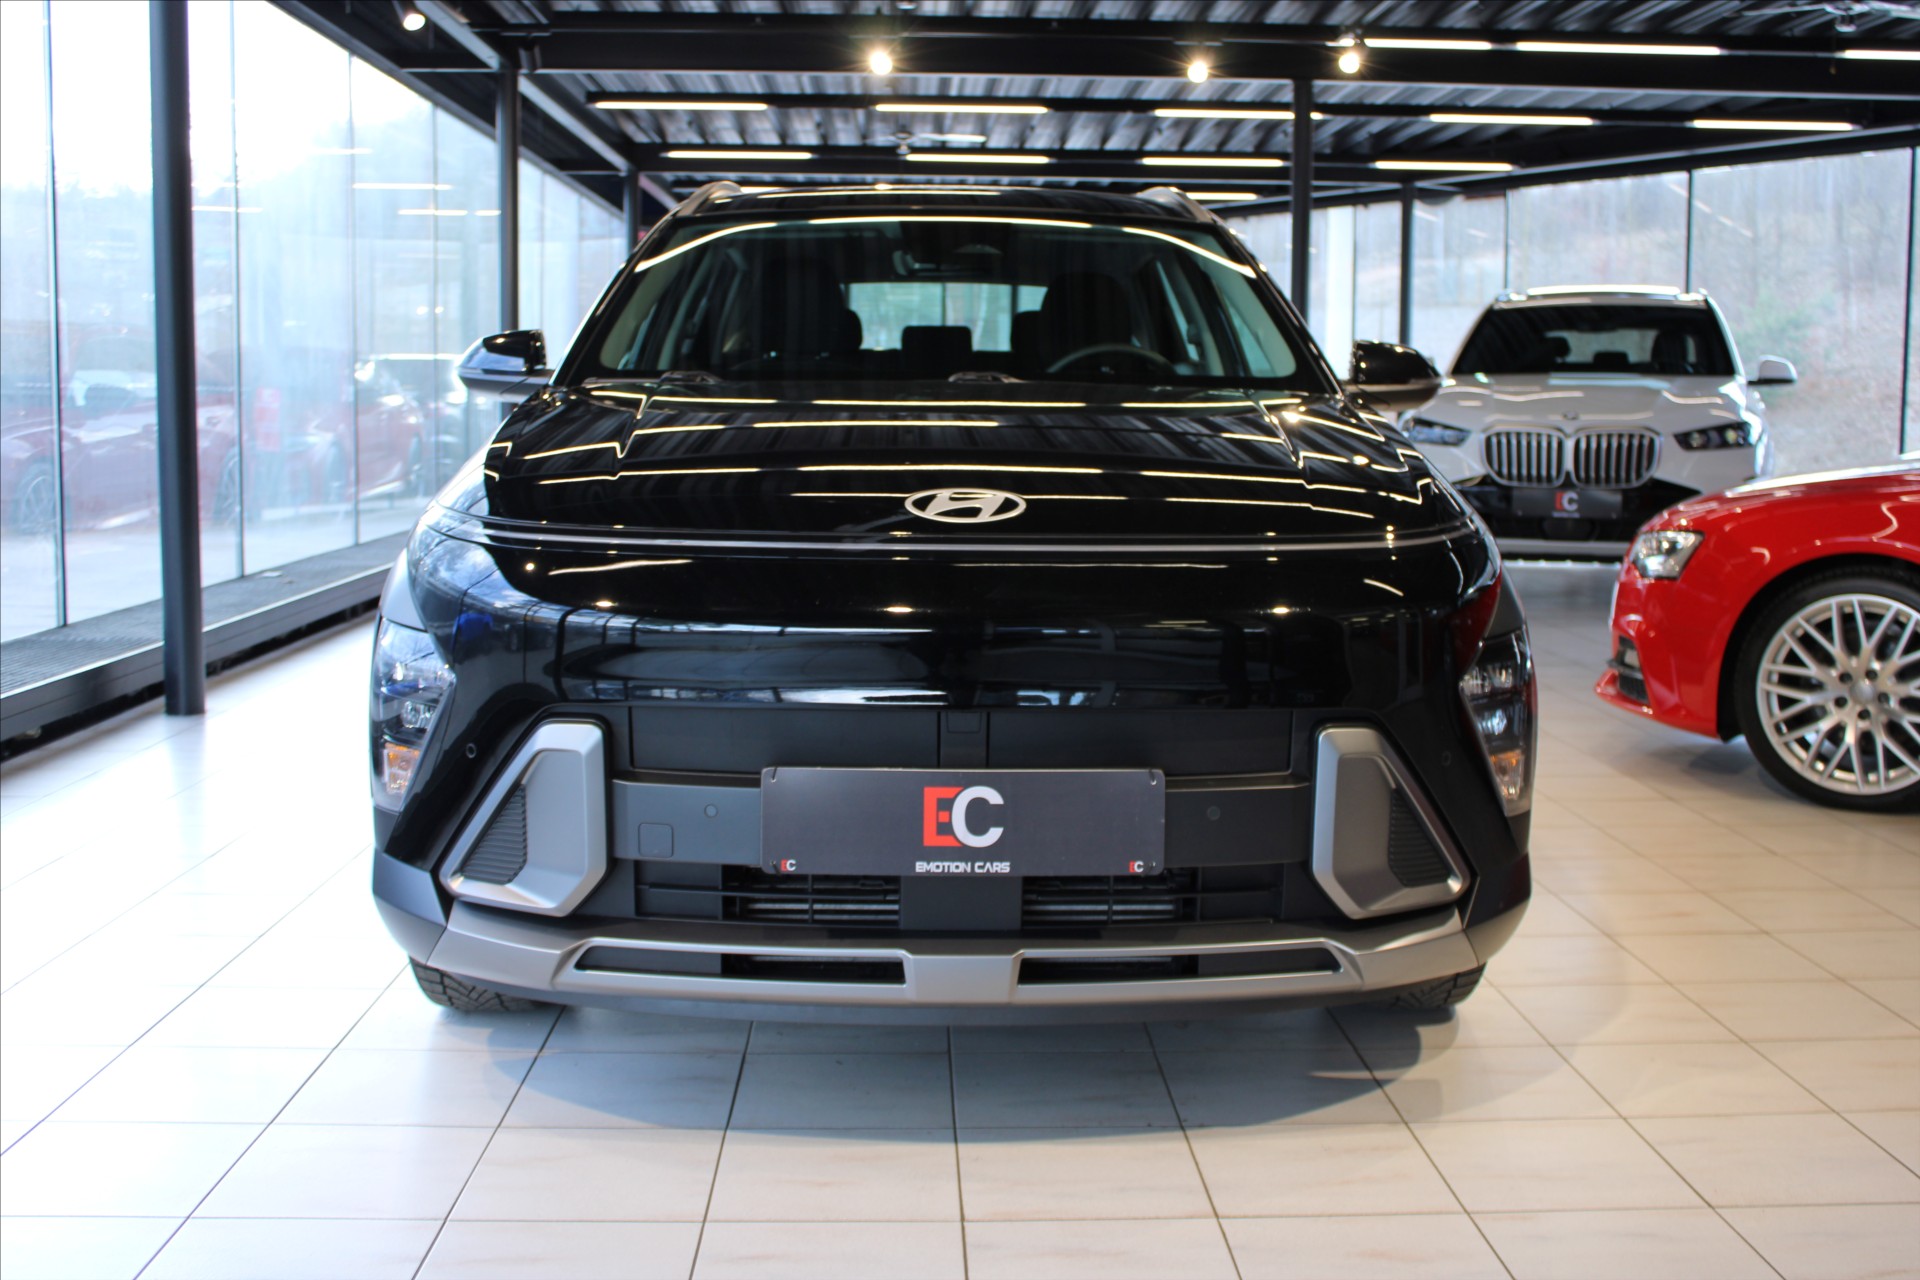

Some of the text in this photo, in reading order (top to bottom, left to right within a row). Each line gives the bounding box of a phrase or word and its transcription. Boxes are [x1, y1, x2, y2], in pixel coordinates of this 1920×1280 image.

[923, 785, 1004, 848] EC
[915, 861, 1010, 873] EMOTION CARS
